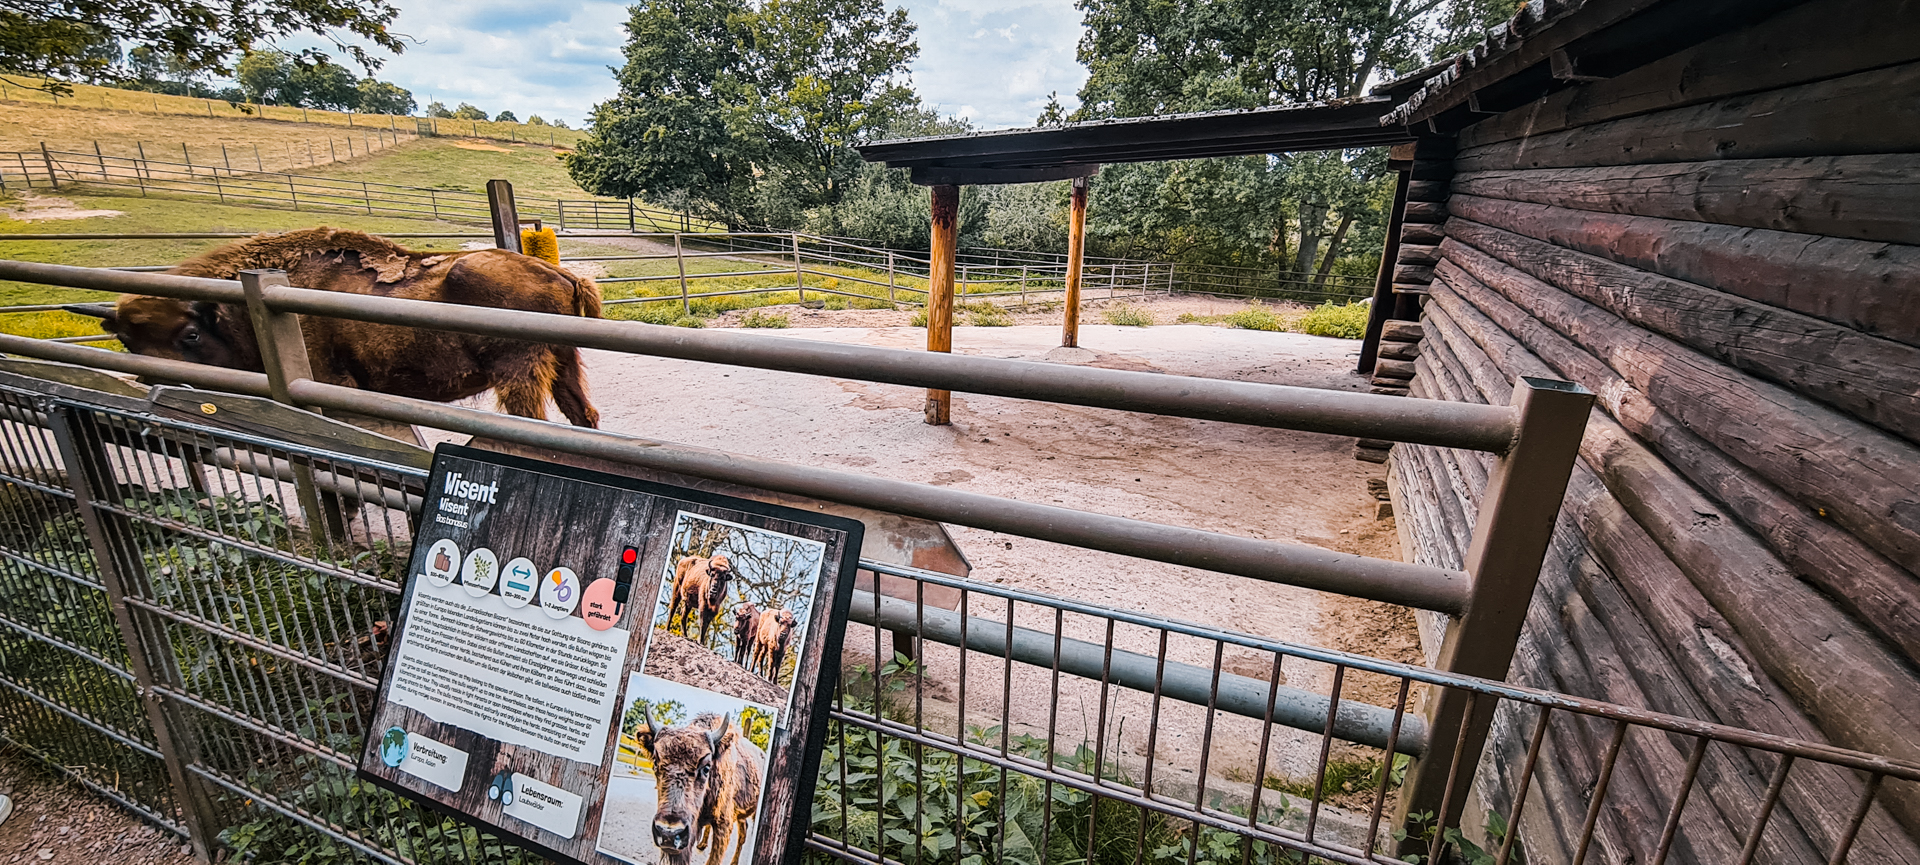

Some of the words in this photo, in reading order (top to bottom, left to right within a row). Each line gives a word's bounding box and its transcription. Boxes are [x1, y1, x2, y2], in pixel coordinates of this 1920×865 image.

[444, 471, 499, 505] Wisent
[439, 497, 469, 516] Wisent
[435, 513, 446, 524] Bos
[590, 602, 603, 610] stark
[587, 611, 611, 622] gefährdet
[413, 741, 448, 764] Verbreitung:
[425, 759, 437, 768] Asien
[518, 796, 544, 811] Laubwälder
[521, 784, 563, 808] Lebensraum:
